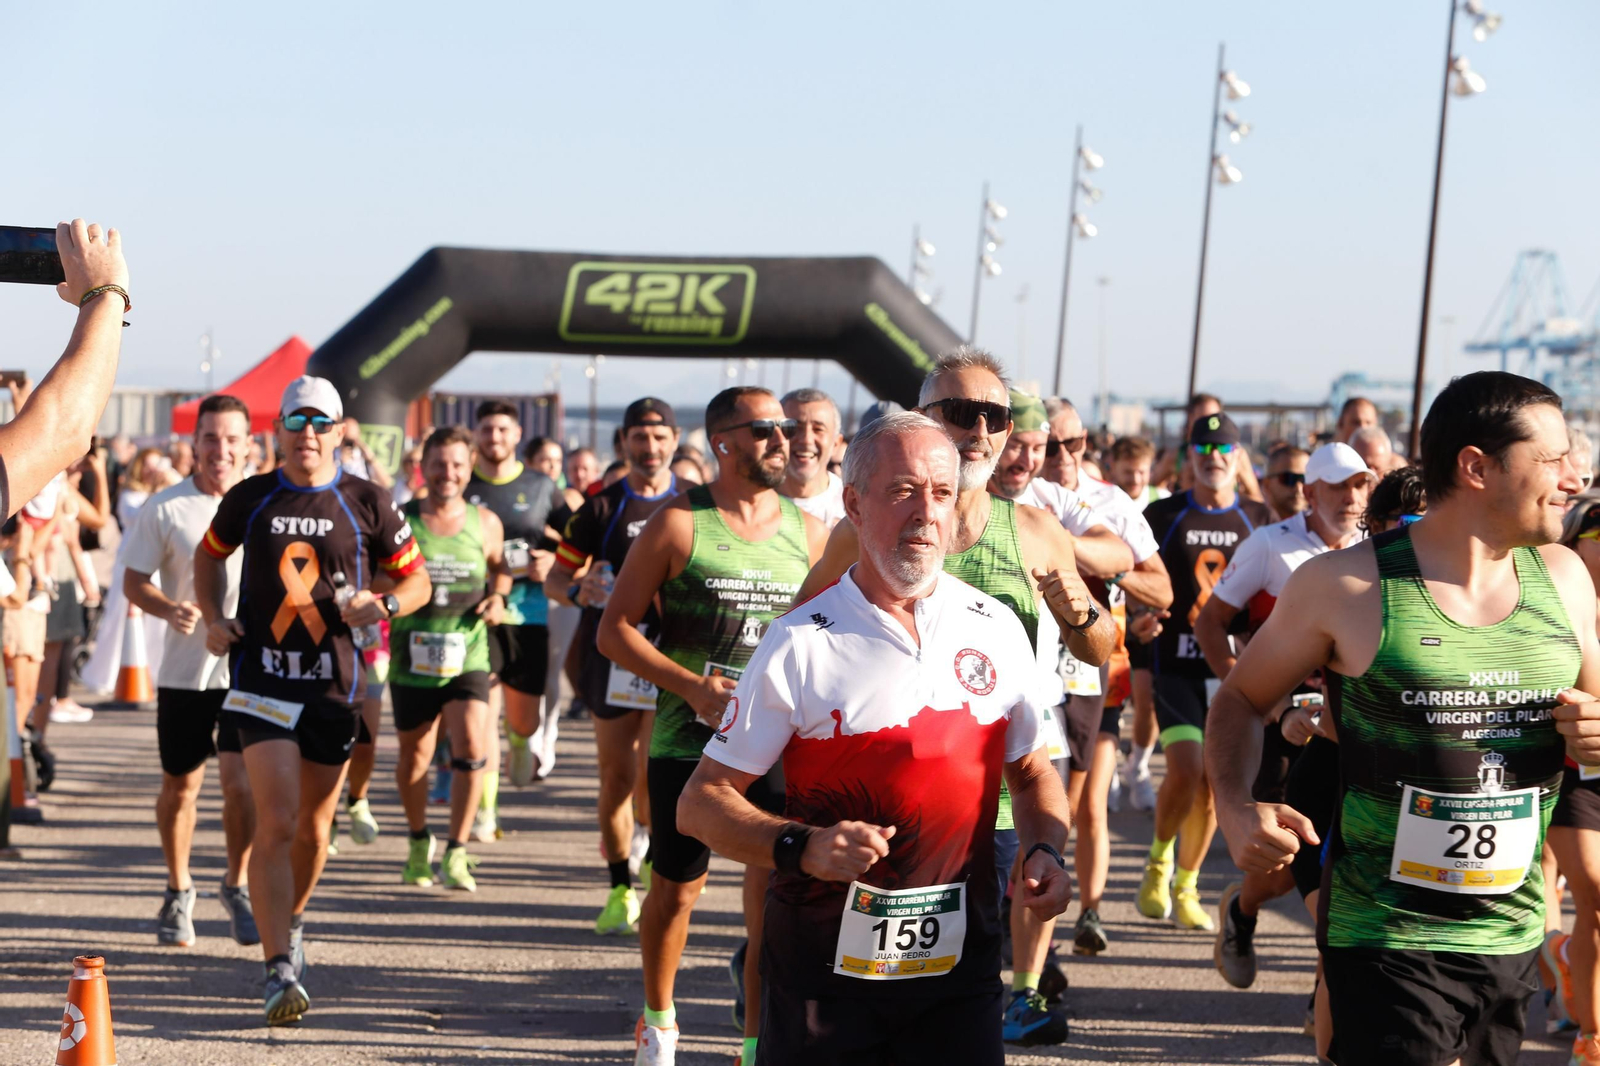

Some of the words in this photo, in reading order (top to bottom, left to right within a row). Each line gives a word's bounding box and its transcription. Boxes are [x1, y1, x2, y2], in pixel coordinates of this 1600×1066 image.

[585, 272, 732, 315] 42K
[271, 516, 334, 536] STOP
[1186, 529, 1238, 547] STOP
[742, 569, 771, 580] XXVII
[705, 578, 754, 591] CARRERA
[718, 591, 749, 601] VIRGEN
[750, 593, 767, 602] DEL
[768, 594, 791, 603] PILAR
[736, 603, 772, 612] ALGECIRAS
[261, 646, 333, 680] ELA
[1469, 671, 1520, 686] XXVII
[1401, 690, 1490, 706] CARRERA
[1495, 687, 1573, 705] POPULA
[1426, 711, 1481, 724] VIRGEN
[1486, 711, 1511, 724] DEL
[1462, 728, 1521, 739] ALGECIRAS
[1439, 799, 1462, 808] XXVII
[1496, 796, 1524, 807] POPULAR
[1451, 811, 1478, 820] VIRGEN
[1479, 811, 1492, 820] DEL
[1493, 810, 1513, 819] PILAR
[1443, 824, 1497, 859] 28
[876, 896, 897, 905] XXVII
[898, 895, 925, 905] CARRERA
[926, 892, 951, 903] POPULAR
[886, 907, 910, 916] VIRGEN
[911, 906, 924, 915] DEL
[925, 904, 942, 913] PILAR
[872, 917, 940, 951] 159
[875, 952, 899, 960] JUAN
[901, 950, 931, 959] PEDRO
